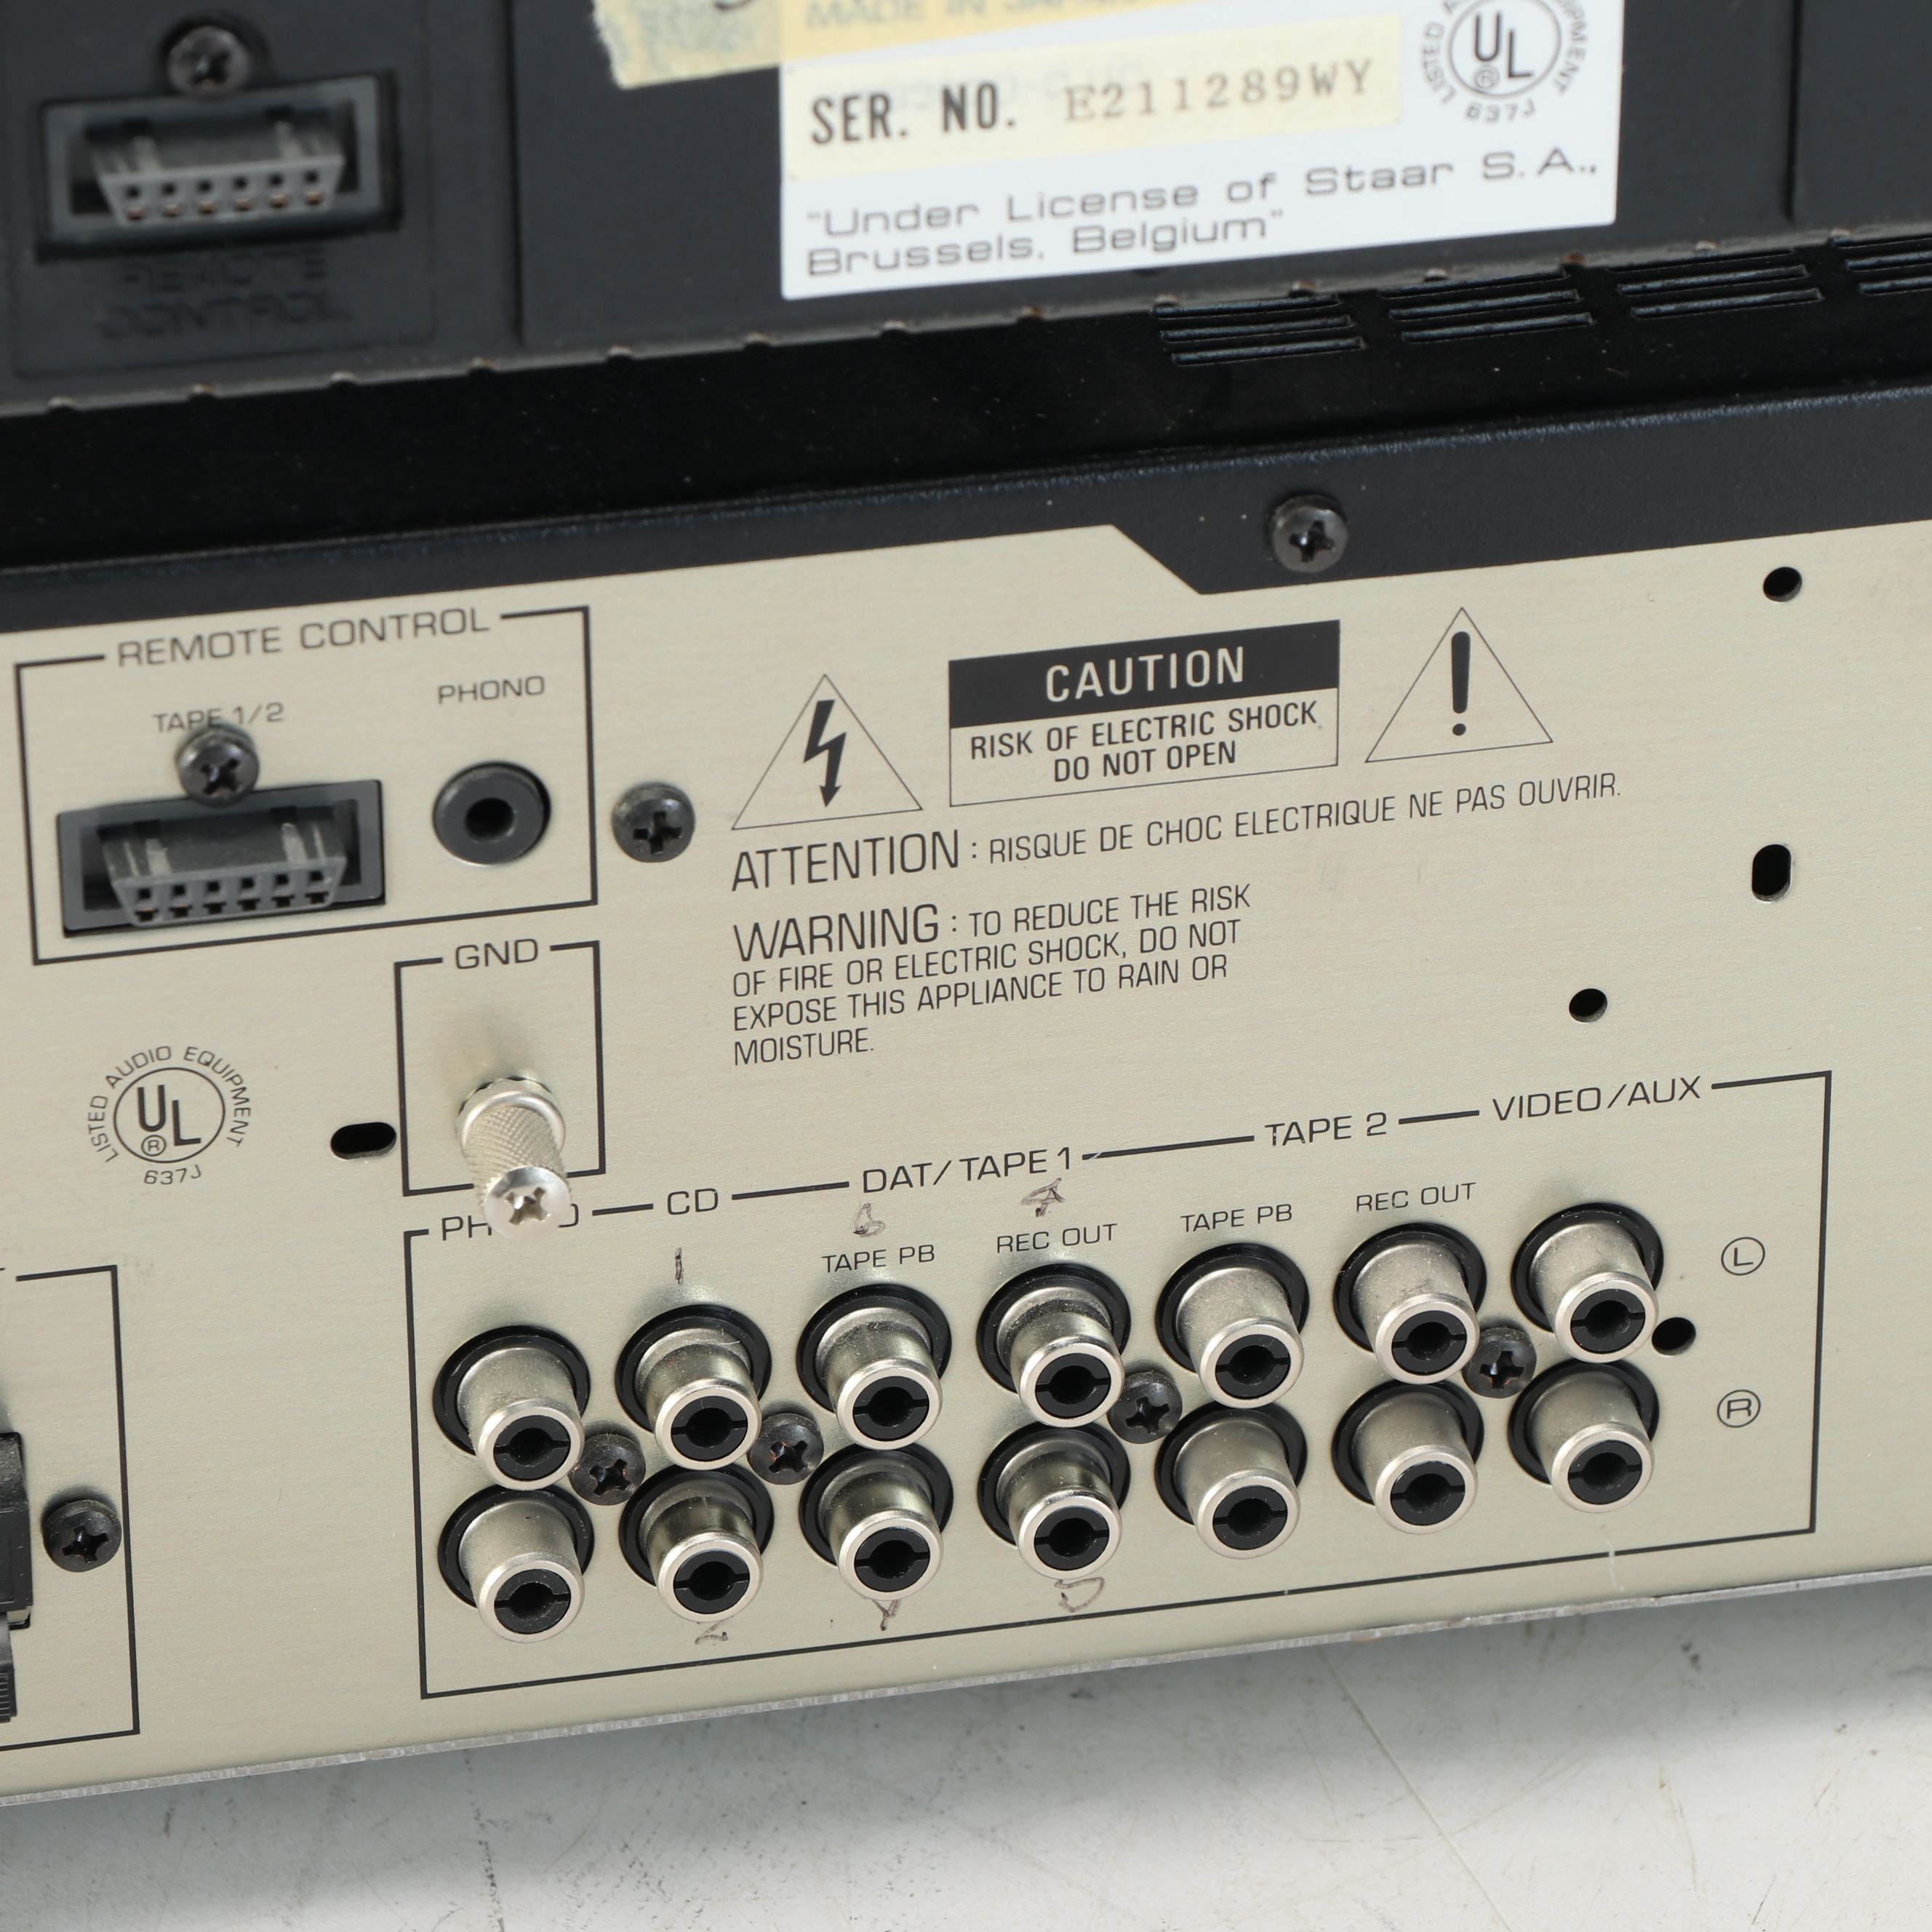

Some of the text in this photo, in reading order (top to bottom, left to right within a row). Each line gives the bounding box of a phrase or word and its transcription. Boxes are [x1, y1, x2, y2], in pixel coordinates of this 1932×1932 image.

[1421, 21, 1457, 106] LISTED
[1474, 11, 1533, 79] UL
[810, 59, 1375, 145] SER. NO. E211289WY
[1465, 97, 1536, 124] 637J
[807, 203, 979, 236] "Under
[1006, 185, 1199, 222] License
[1227, 172, 1277, 204] of
[1305, 161, 1455, 196] Staar
[1074, 209, 1283, 253] Belgium"
[118, 608, 490, 667] REMOTE CONTROL
[438, 675, 546, 704] PHONO
[1045, 646, 1245, 703] CAUTION
[152, 702, 284, 733] TAPE 1/2
[972, 700, 1317, 760] RISK OF ELECTRIC SHOCK
[1055, 741, 1236, 782] DO NOT OPEN
[732, 829, 959, 892] ATTENTION
[990, 830, 1087, 864] RISQUE
[1100, 823, 1133, 852] DE
[1147, 815, 1222, 847] CHOC
[1235, 796, 1397, 838] ELECTRIQUE
[1409, 791, 1443, 819] NE
[1456, 784, 1506, 814] PAS
[1519, 773, 1621, 806] OUVRIR.
[733, 903, 939, 962] WARNING
[969, 910, 1001, 937] TO
[1015, 897, 1119, 933] REDUCE
[1130, 890, 1178, 919] THE
[1192, 883, 1251, 914] RISK
[455, 938, 540, 970] GND
[733, 919, 1241, 997] OF FIRE OR ELECTRIC SHOCK, DO NOT
[734, 954, 1227, 1031] EXPOSE THIS APPLIANCE TO RAIN OR
[735, 1027, 874, 1066] MOISTURE.
[88, 1046, 251, 1162] LISTED AUDIO EQUIPMENT
[137, 1085, 201, 1147] UL
[1492, 1076, 1702, 1122] VIDEO/AUX
[1265, 1112, 1387, 1147] TAPE 2
[144, 1165, 201, 1184] 637J
[863, 1146, 1071, 1194] DAT/TAPE 1
[666, 1188, 719, 1216] CD
[1181, 1203, 1293, 1234] TAPE PB
[1356, 1182, 1477, 1213] REC OUT
[822, 1244, 935, 1274] TAPE PB
[997, 1223, 1118, 1253] REC OUT
